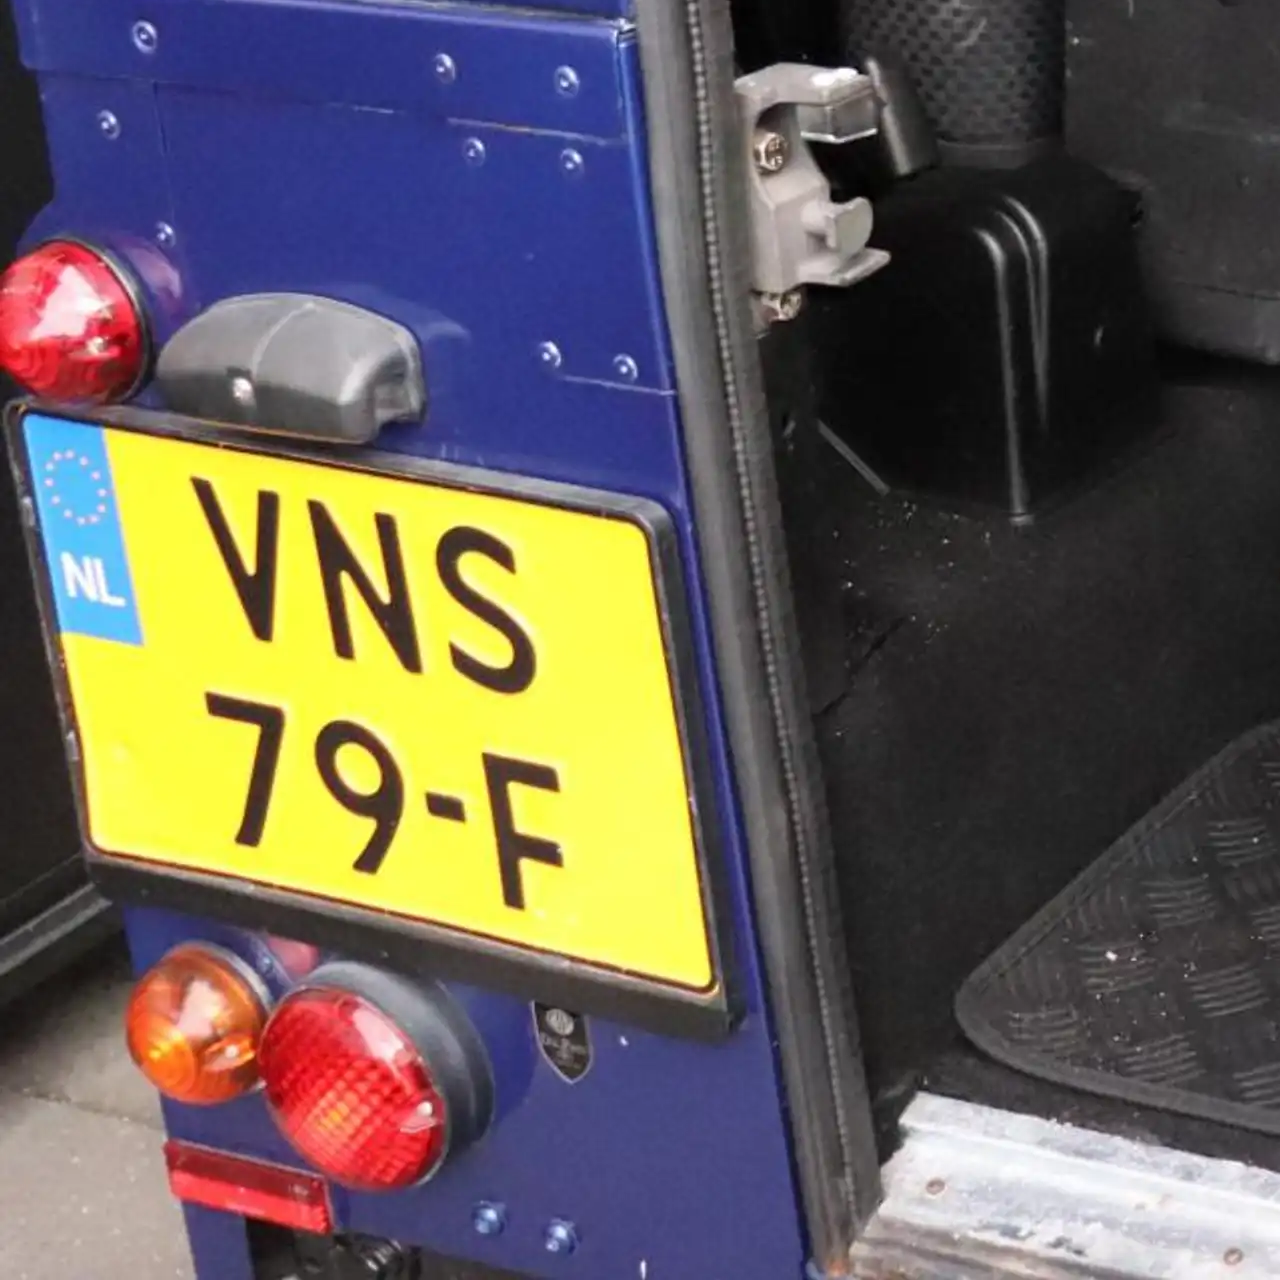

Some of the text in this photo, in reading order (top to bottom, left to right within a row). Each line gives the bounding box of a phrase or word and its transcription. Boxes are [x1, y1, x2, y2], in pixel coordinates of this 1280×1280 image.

[60, 551, 126, 607] NL
[190, 476, 537, 695] VNS
[204, 691, 564, 911] 79-F
